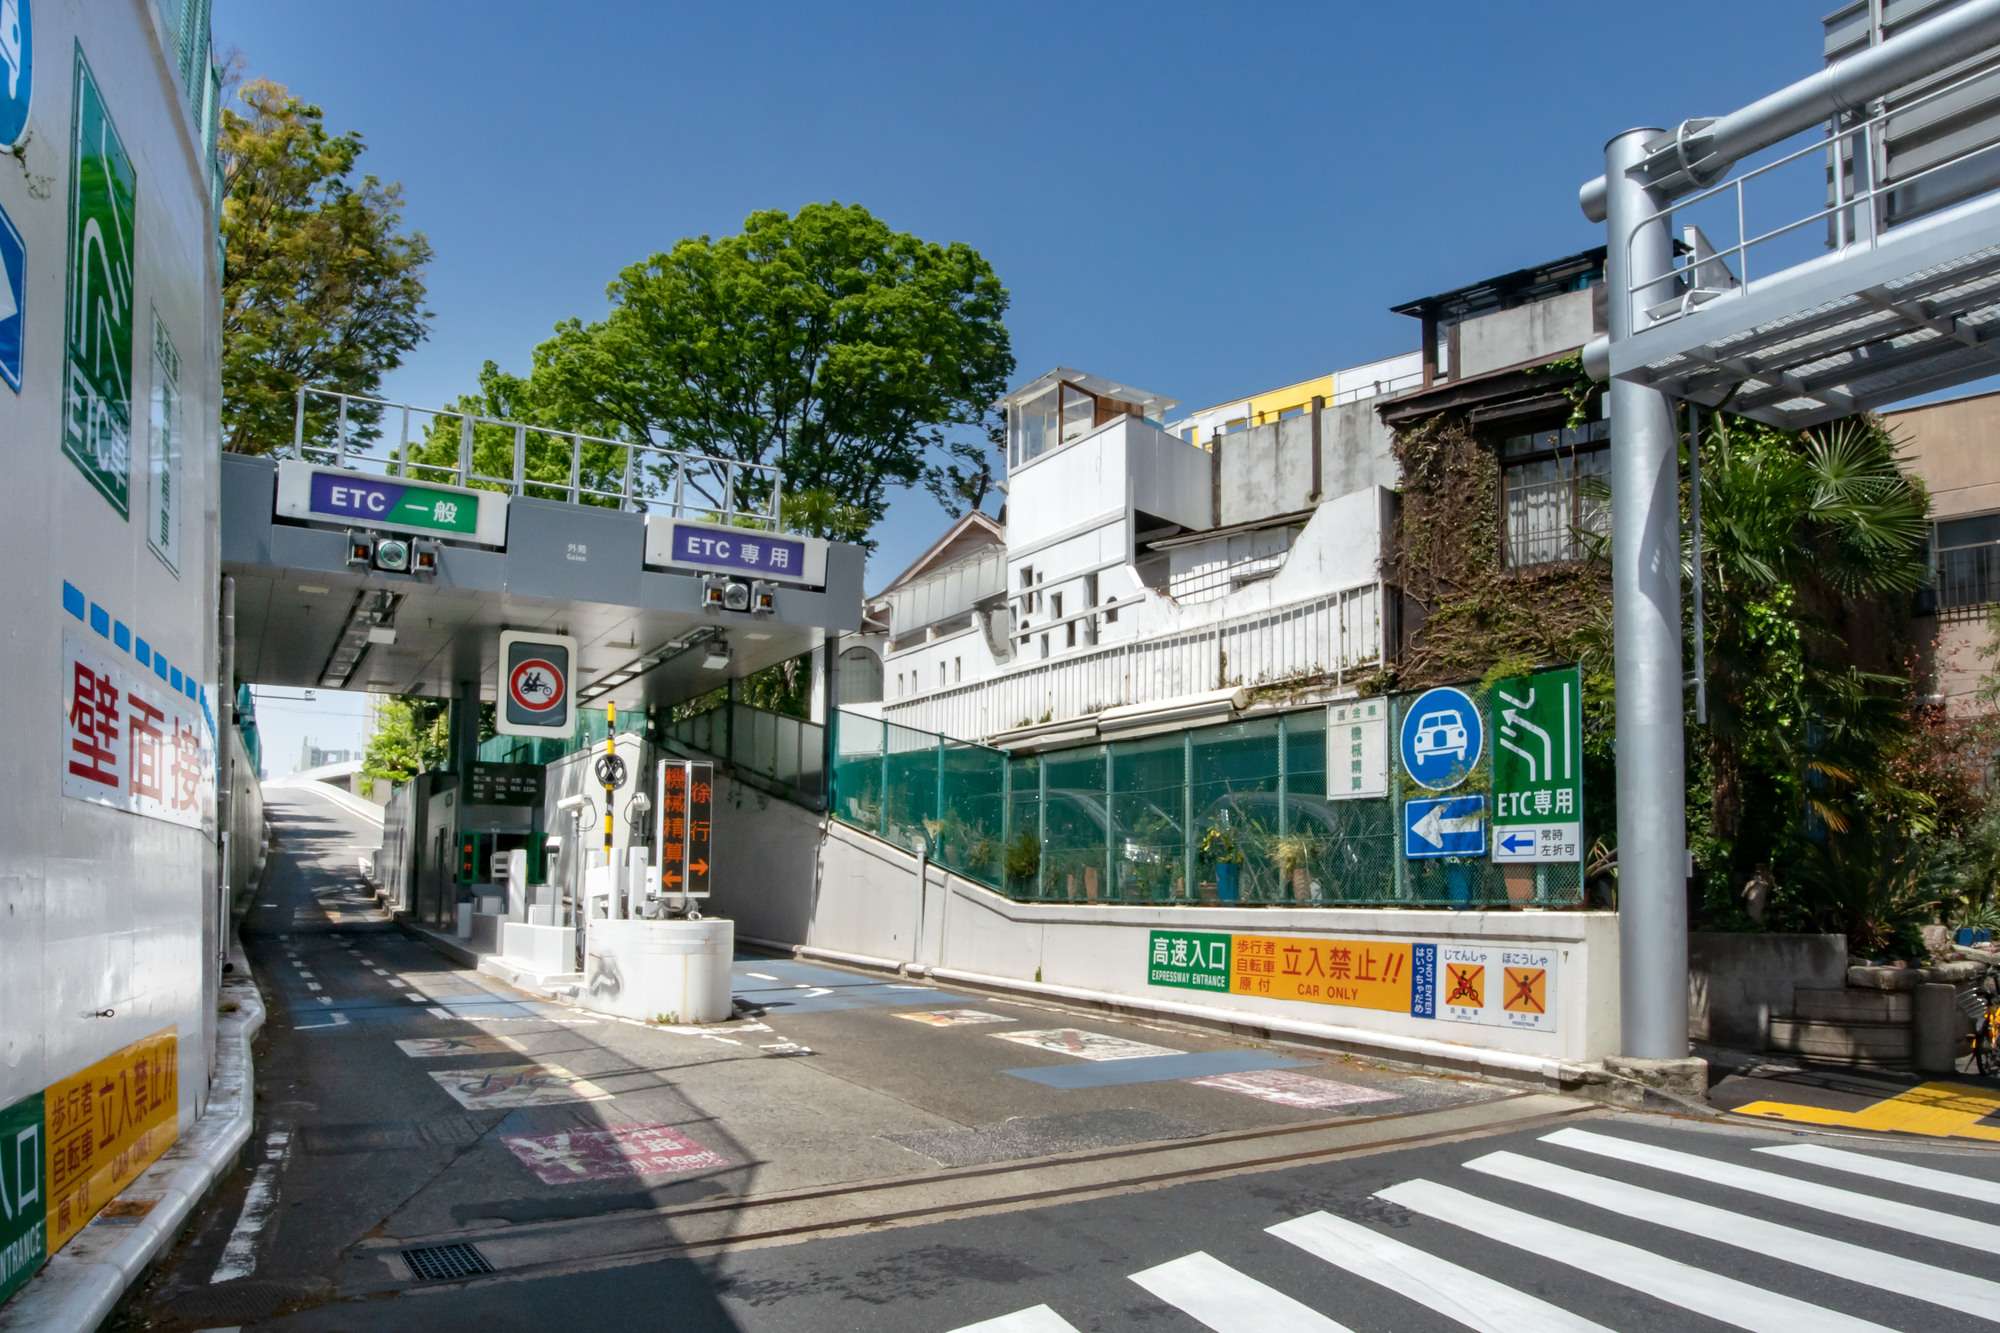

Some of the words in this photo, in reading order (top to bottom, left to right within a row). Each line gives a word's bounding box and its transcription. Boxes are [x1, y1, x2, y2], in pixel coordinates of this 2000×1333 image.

[331, 486, 385, 512] ETC
[405, 500, 457, 523] 一般
[688, 536, 730, 558] ETC
[740, 543, 789, 568] 専用
[69, 660, 199, 813] 壁面接
[691, 782, 711, 841] 徐行
[1498, 788, 1573, 816] ETC専用
[1541, 829, 1563, 840] 常時
[1541, 844, 1575, 857] 左折可
[1153, 937, 1226, 970] 高速入口
[1237, 940, 1276, 955] 歩行者
[1425, 948, 1434, 962] DO
[1444, 949, 1488, 961] じてんしゃ
[1502, 952, 1548, 966] ほこうしゃ
[1237, 958, 1275, 973] 自転車
[1425, 963, 1433, 983] NOT
[1152, 969, 1189, 983] EXPRESSWAY
[1192, 973, 1225, 987] ENTRANCE
[1239, 976, 1270, 993] 原付
[1414, 947, 1425, 1013] はいっちゃだめ
[1297, 983, 1319, 997] CAR
[1327, 985, 1358, 1000] ONLY
[1424, 984, 1433, 1015] ENTER
[52, 1080, 93, 1134] 歩行者
[53, 1129, 93, 1187] 自転車
[57, 1177, 90, 1234] 原付
